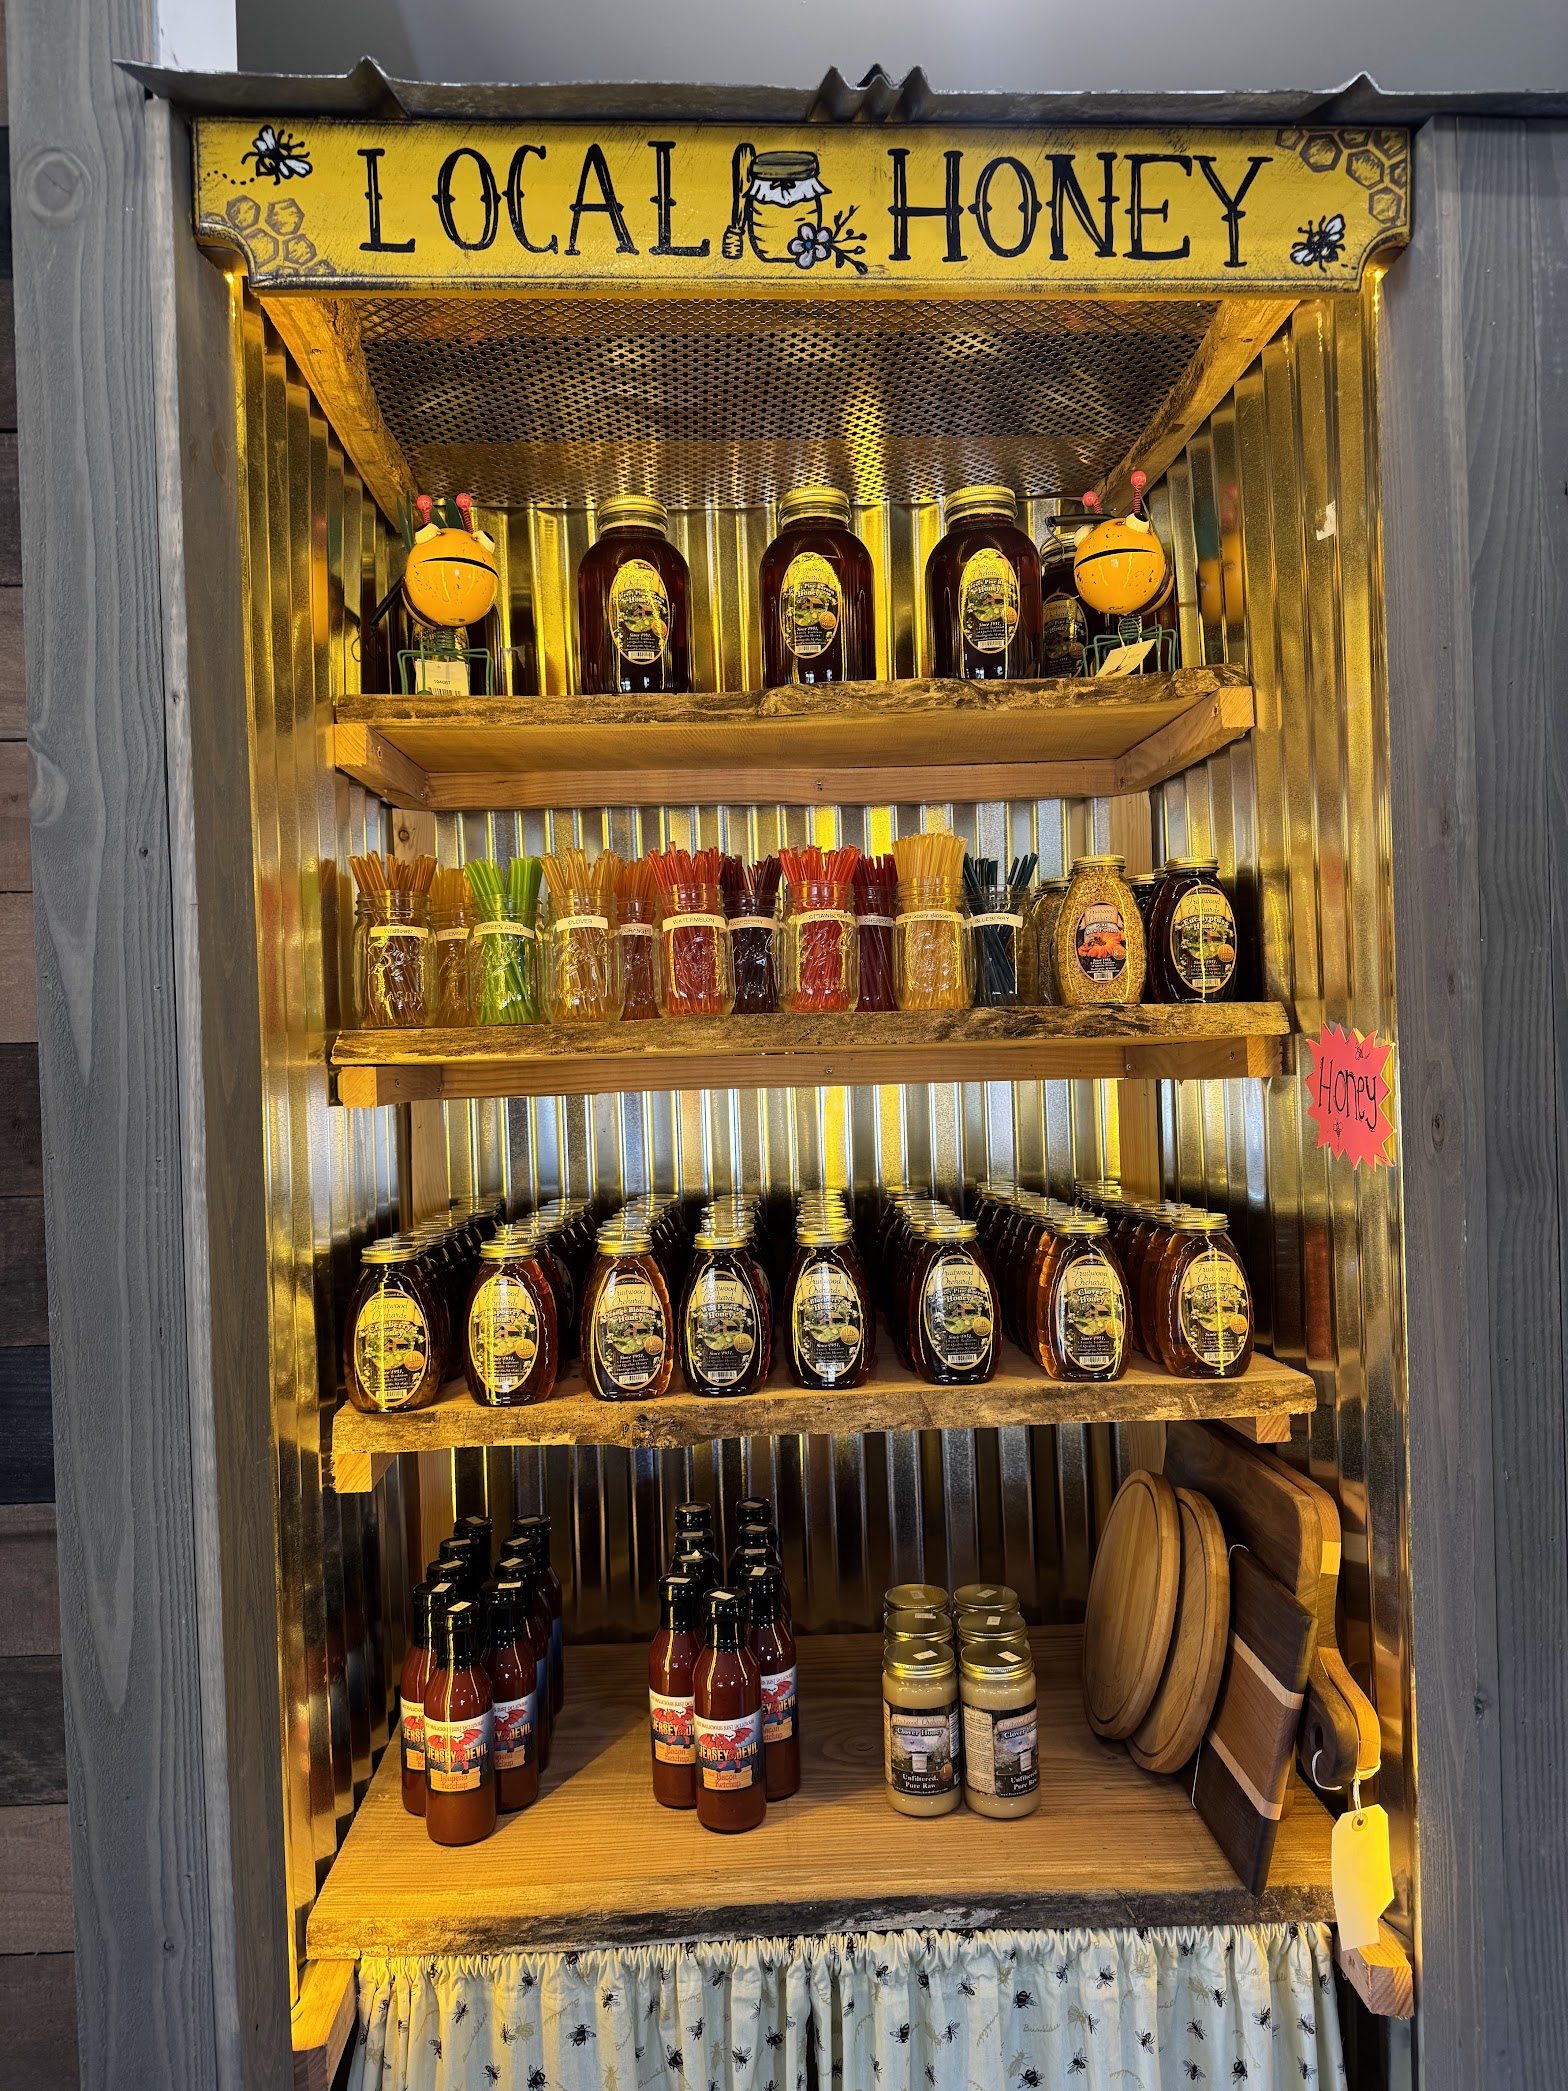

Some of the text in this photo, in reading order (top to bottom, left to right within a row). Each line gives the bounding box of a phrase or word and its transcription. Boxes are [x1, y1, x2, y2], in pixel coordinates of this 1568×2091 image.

[357, 141, 1274, 267] LOCAL HONEY
[796, 588, 820, 599] Honey
[977, 585, 1002, 594] Honey
[567, 918, 593, 926] CLOVER
[672, 917, 715, 926] WATERMELON
[808, 913, 849, 921] STRAWBERRY
[863, 917, 889, 925] CHERRY
[974, 915, 1010, 923] BLUEBERRY
[482, 924, 524, 933] GREEN APPLE
[1193, 923, 1218, 932] Hney
[1317, 1055, 1378, 1131] Honey
[938, 1266, 975, 1278] ruitwood
[1071, 1267, 1109, 1279] Fruitwood
[1194, 1263, 1232, 1276] Fruitood
[805, 1274, 842, 1287] Fruwood
[940, 1275, 974, 1287] Orchards
[1074, 1277, 1107, 1288] Orchards
[1196, 1272, 1231, 1284] Orchrds
[484, 1287, 521, 1298] Fuitwood
[608, 1285, 647, 1298] ruitwood
[702, 1282, 738, 1294] Fitwood
[807, 1284, 841, 1297] Orchrds
[952, 1287, 967, 1296] Pine
[967, 1288, 988, 1299] Barren
[1077, 1288, 1105, 1297] Clover
[1200, 1283, 1229, 1293] Cloer
[485, 1296, 519, 1308] Ochards
[611, 1296, 646, 1308] Orchards
[703, 1291, 736, 1303] Ohards
[808, 1296, 842, 1306] Blueerry
[945, 1294, 972, 1304] Honey
[1079, 1295, 1106, 1305] Honey
[1202, 1291, 1229, 1302] Hoey
[370, 1299, 409, 1312] Fritwood
[700, 1303, 741, 1314] Wild Flower
[813, 1302, 840, 1313] Honey
[371, 1309, 407, 1322] Ochards
[485, 1309, 522, 1319] Rpberry
[603, 1306, 657, 1320] Orange Blossom
[617, 1313, 643, 1324] Honey
[708, 1310, 734, 1321] Honey
[491, 1315, 517, 1325] oney
[368, 1320, 412, 1333] Crnberry
[377, 1329, 406, 1339] oney
[778, 1694, 797, 1712] DEVIL
[451, 1725, 463, 1733] JUST
[509, 1722, 533, 1740] DEVIL
[651, 1721, 680, 1737] JERSEY
[701, 1722, 723, 1731] MALICIOUS
[723, 1724, 734, 1732] JUST
[733, 1719, 755, 1730] DELICIOUS
[403, 1726, 425, 1742] JERSE
[762, 1731, 784, 1742] etchup
[896, 1727, 945, 1738] Clover Honey
[1003, 1729, 1026, 1740] Clover
[426, 1746, 457, 1763] JERSEY
[464, 1742, 489, 1760] DEVIL
[495, 1752, 513, 1761] apeno
[665, 1746, 687, 1756] Bacon
[698, 1741, 759, 1762] JERSEY DEVIL
[495, 1760, 514, 1768] tchup
[664, 1753, 690, 1764] Ketchup
[716, 1772, 738, 1781] Bacon
[441, 1780, 469, 1790] Ketchup
[715, 1779, 741, 1790] Ketchup
[905, 1781, 921, 1790] Pure
[922, 1781, 937, 1790] Raw
[1013, 1780, 1028, 1791] Pure
